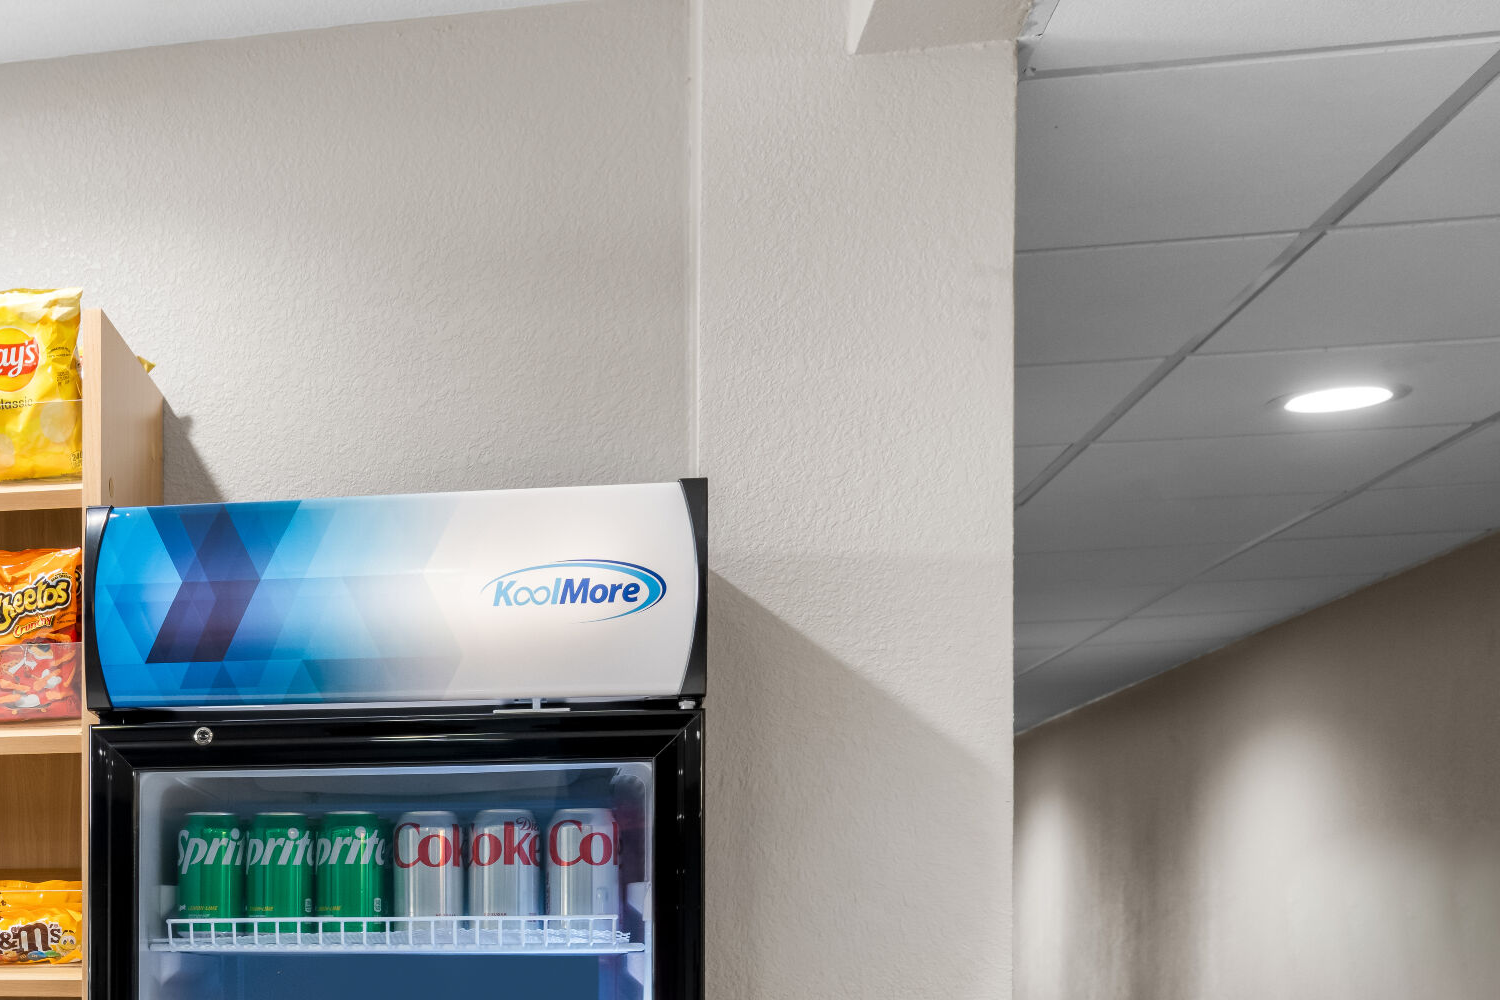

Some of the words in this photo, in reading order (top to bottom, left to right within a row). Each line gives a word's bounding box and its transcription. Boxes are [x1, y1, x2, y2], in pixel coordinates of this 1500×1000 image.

[493, 577, 641, 607] KoolMore
[13, 614, 54, 638] Crunchy
[469, 820, 541, 869] oke
